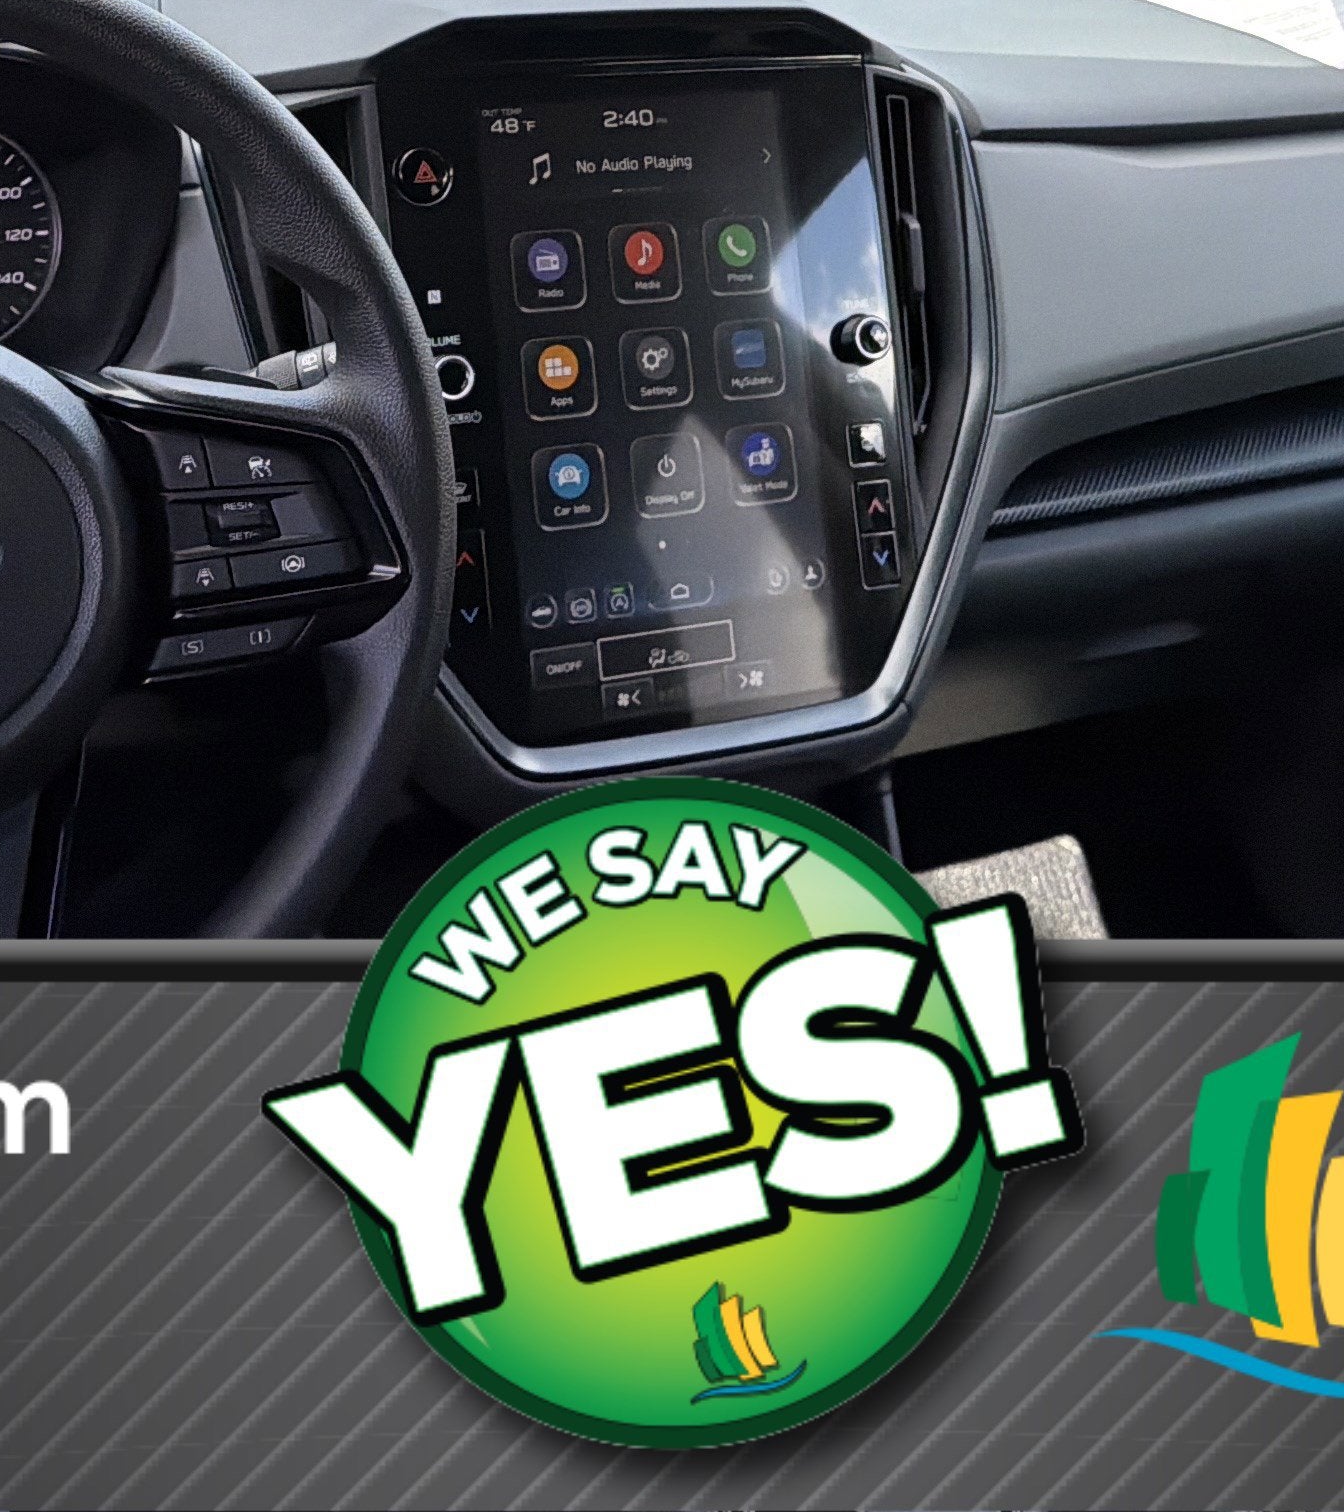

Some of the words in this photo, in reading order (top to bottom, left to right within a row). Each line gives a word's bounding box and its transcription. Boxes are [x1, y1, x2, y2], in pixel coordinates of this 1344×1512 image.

[602, 108, 655, 129] 2:40
[575, 159, 596, 175] No
[601, 156, 639, 173] Audio
[643, 154, 693, 173] Playing
[5, 228, 34, 242] 120
[634, 278, 662, 290] Media
[726, 271, 754, 284] Phone
[537, 287, 565, 300] Radio
[640, 384, 678, 399] Settings
[550, 394, 574, 409] Apps
[553, 504, 572, 518] Car
